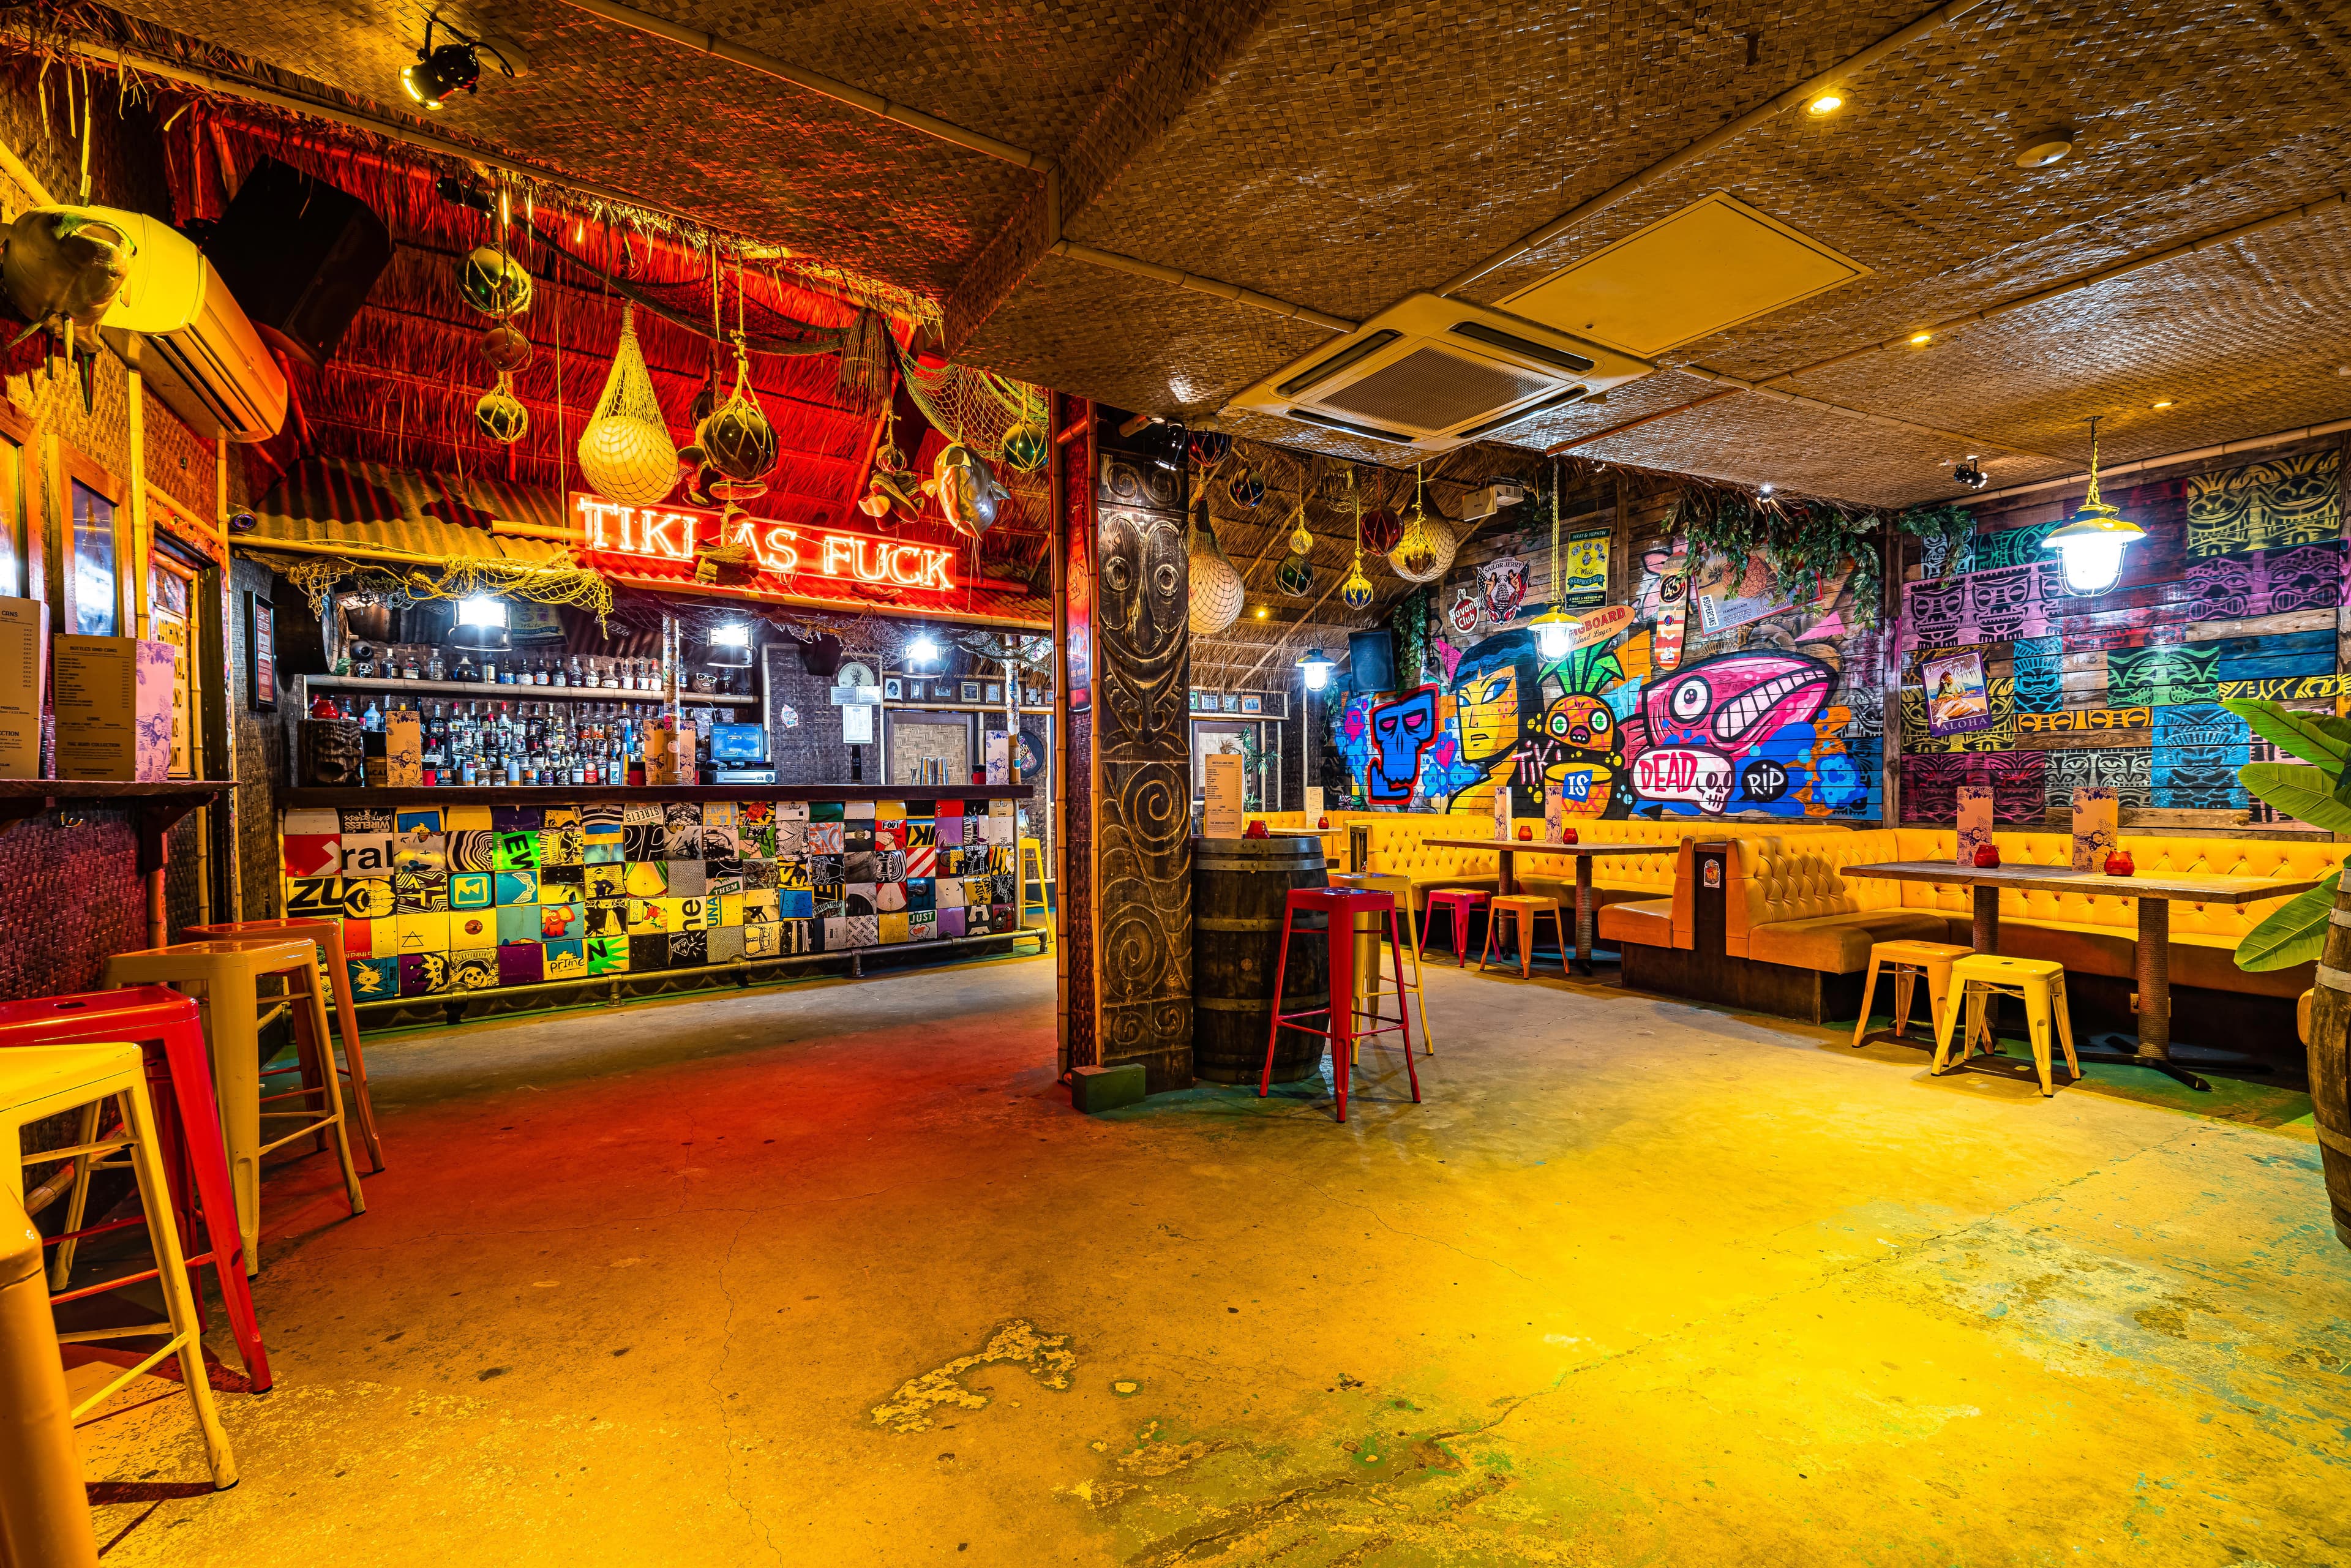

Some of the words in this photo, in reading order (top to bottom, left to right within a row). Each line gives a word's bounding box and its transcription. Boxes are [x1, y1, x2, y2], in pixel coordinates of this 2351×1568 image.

[579, 497, 697, 558] TIKI
[730, 522, 798, 570] AS
[823, 535, 954, 604] FUCK
[1485, 562, 1504, 574] SAILOR
[1569, 577, 1592, 585] OVERPROOF
[1449, 599, 1479, 623] Havana
[1702, 596, 1717, 626] #SUPERCANS
[1722, 603, 1748, 614] HAWAIIAN
[1723, 608, 1752, 621] BROKEN
[1458, 613, 1475, 628] Club
[1725, 613, 1753, 626] SLICES
[1593, 628, 1612, 638] Lager
[1940, 717, 1988, 732] ALOHA
[1638, 751, 1698, 793] DEAD
[1568, 774, 1589, 797] IS
[626, 806, 659, 823] STREETS
[344, 821, 390, 830] WIRELESS
[882, 822, 900, 830] FOOT
[713, 883, 738, 895] THEM
[910, 912, 933, 923] JUST
[848, 921, 858, 931] stool
[860, 922, 870, 931] stool
[852, 934, 862, 943] stool
[863, 934, 873, 943] stool
